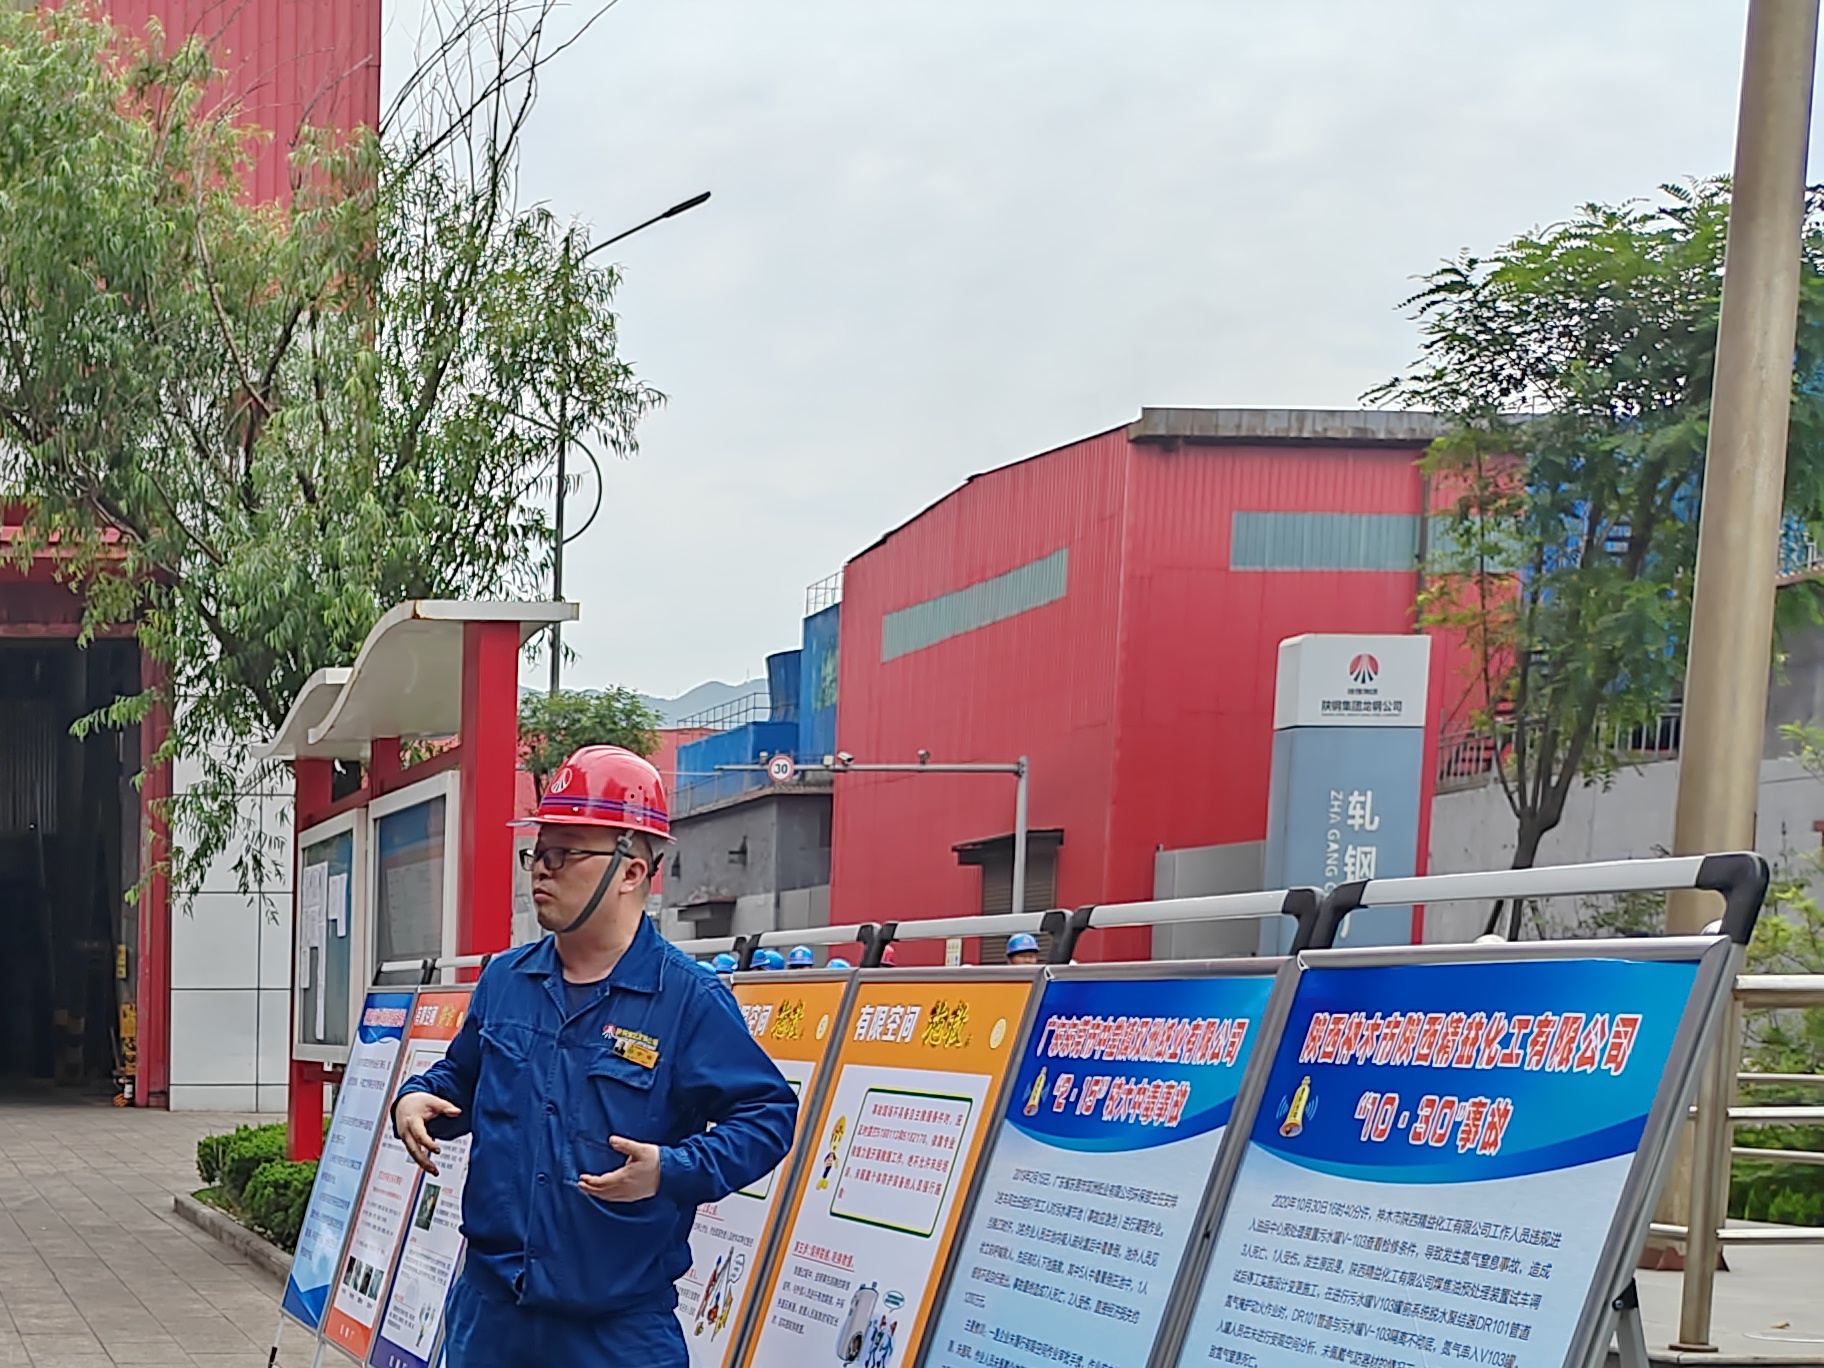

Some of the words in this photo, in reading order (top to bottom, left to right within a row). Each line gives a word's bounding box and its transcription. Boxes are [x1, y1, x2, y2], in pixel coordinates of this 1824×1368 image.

[774, 763, 788, 774] 30
[1329, 790, 1344, 824] ZHA
[1325, 829, 1341, 878] GANG
[852, 1003, 921, 1043] 有限空间
[1299, 1012, 1642, 1076] 陕西神木市陕西精益化工有限公司
